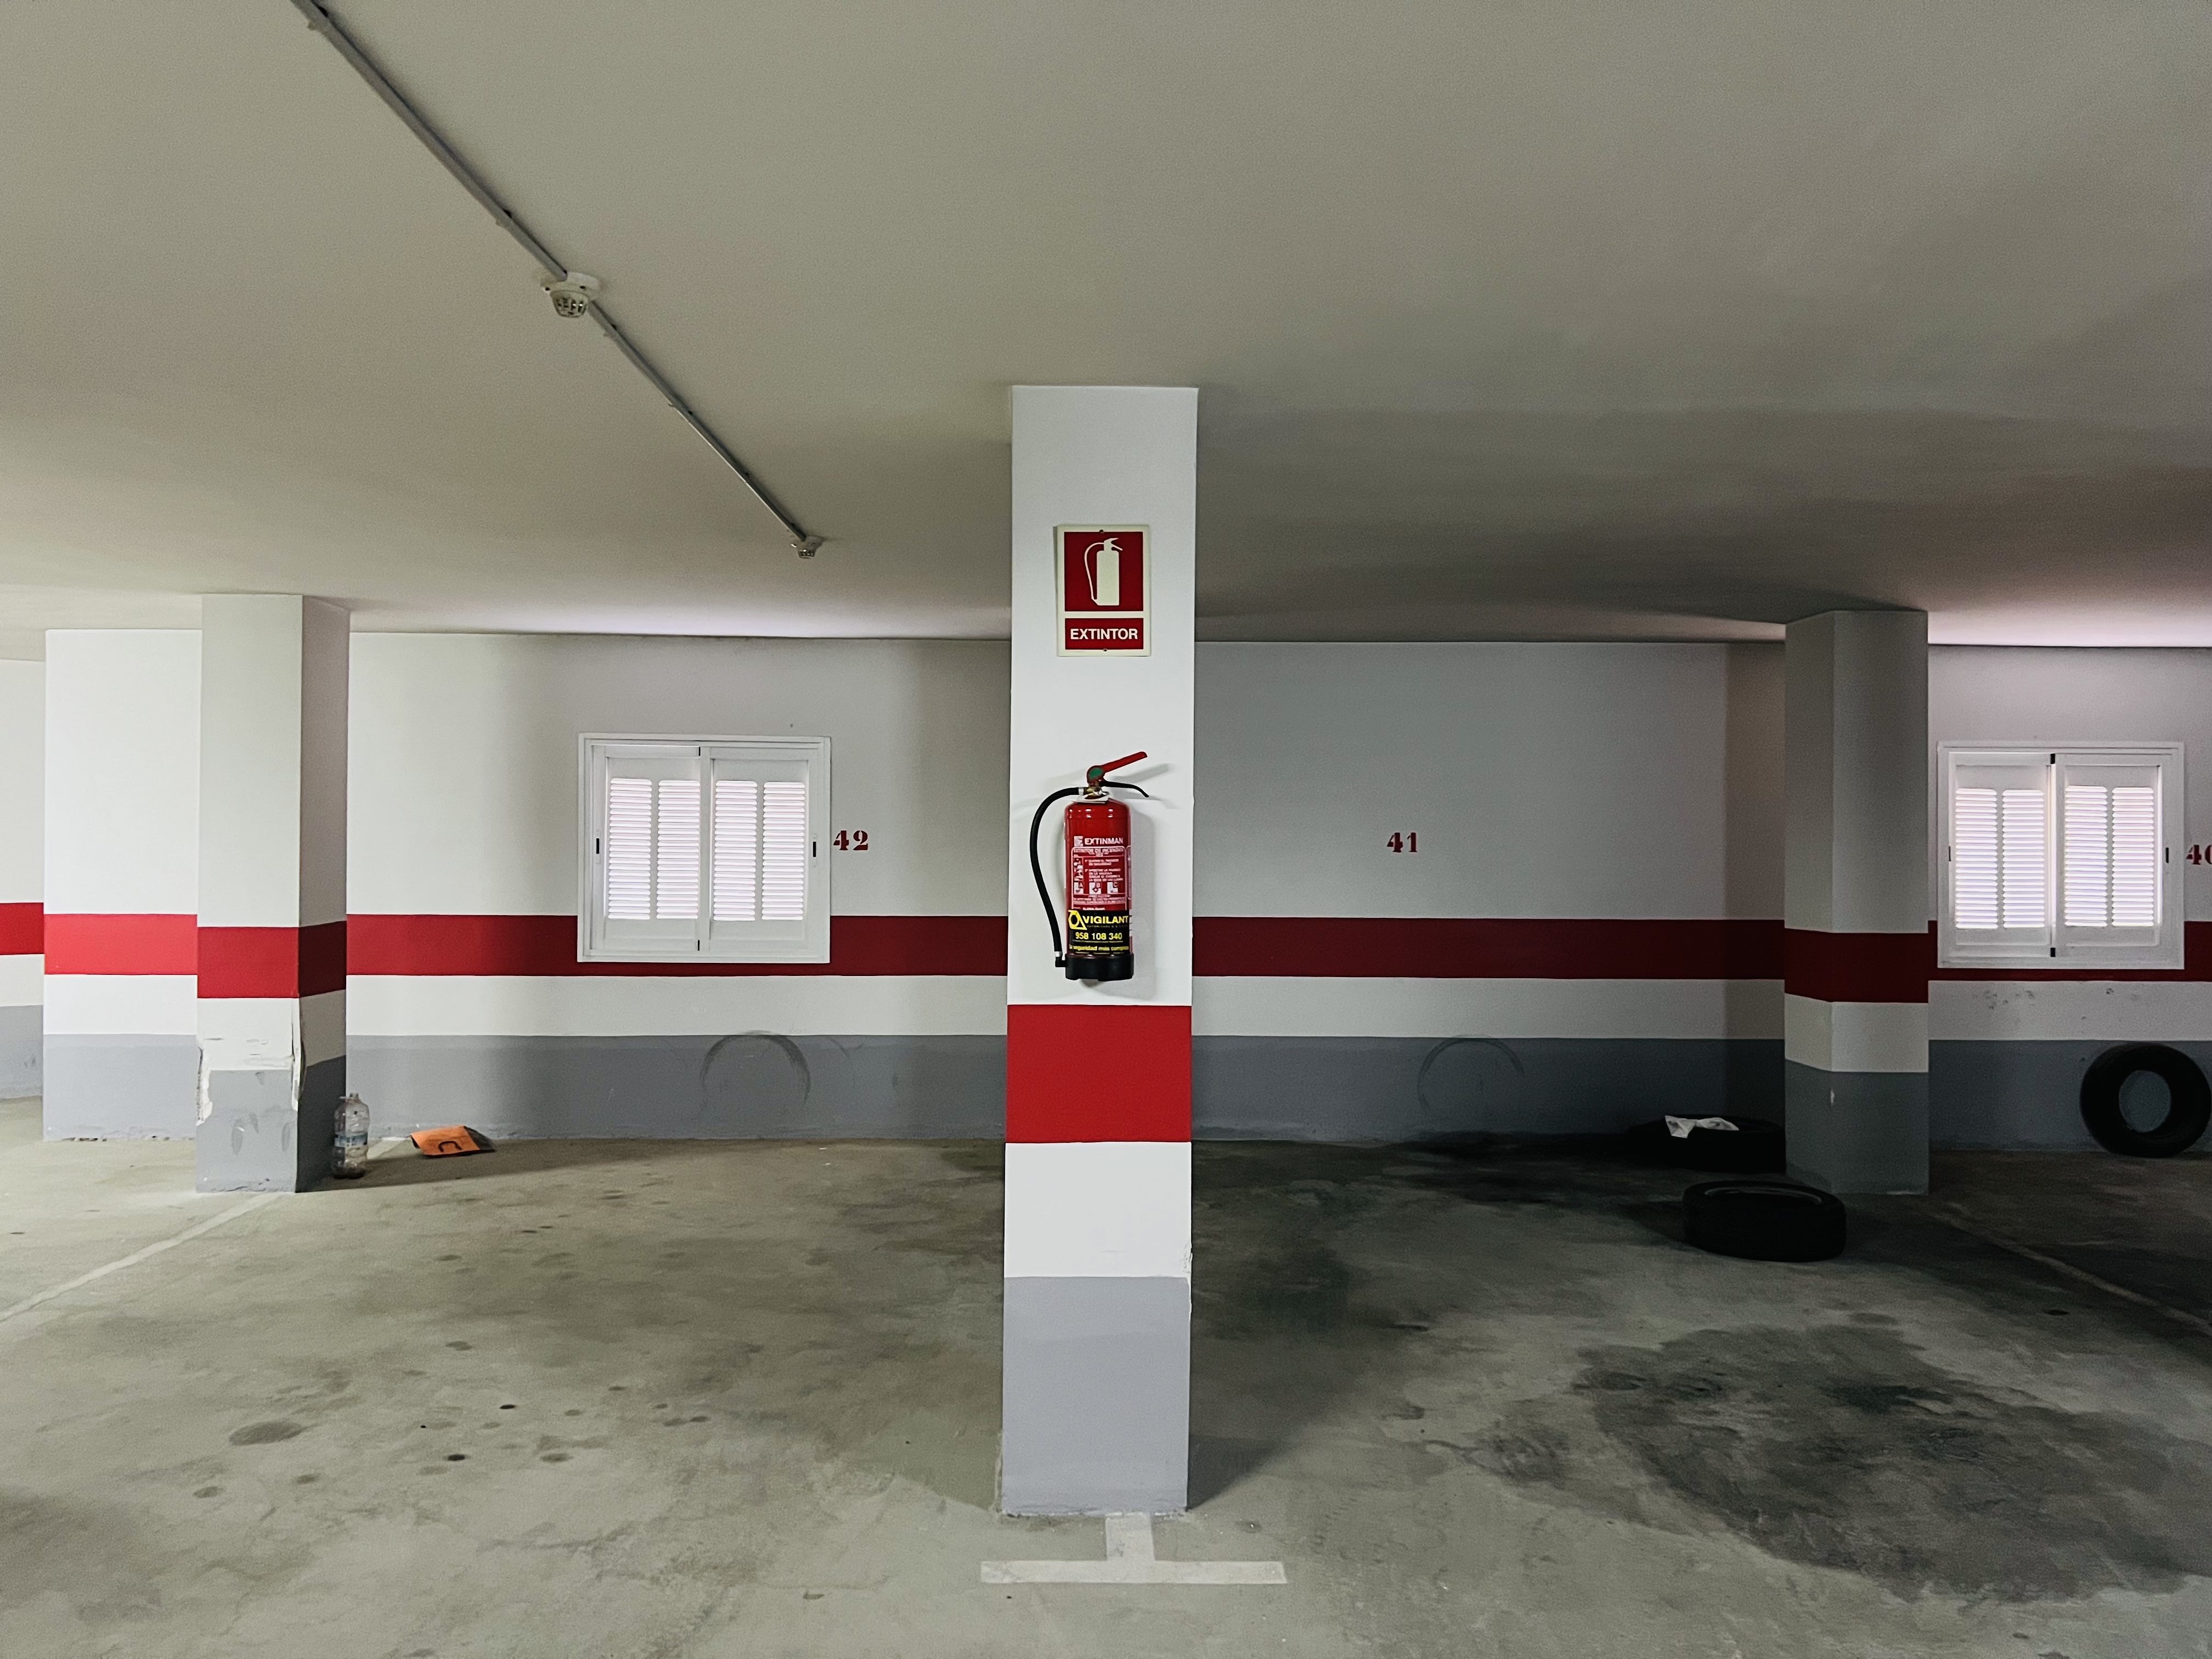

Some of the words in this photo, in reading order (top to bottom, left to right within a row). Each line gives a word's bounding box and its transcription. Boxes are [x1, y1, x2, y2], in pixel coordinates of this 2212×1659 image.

[1070, 628, 1138, 640] EXTINTOR
[833, 830, 868, 851] 42
[1386, 832, 1418, 853] 41
[1082, 915, 1129, 924] VIGILANT
[1075, 932, 1088, 940] 958
